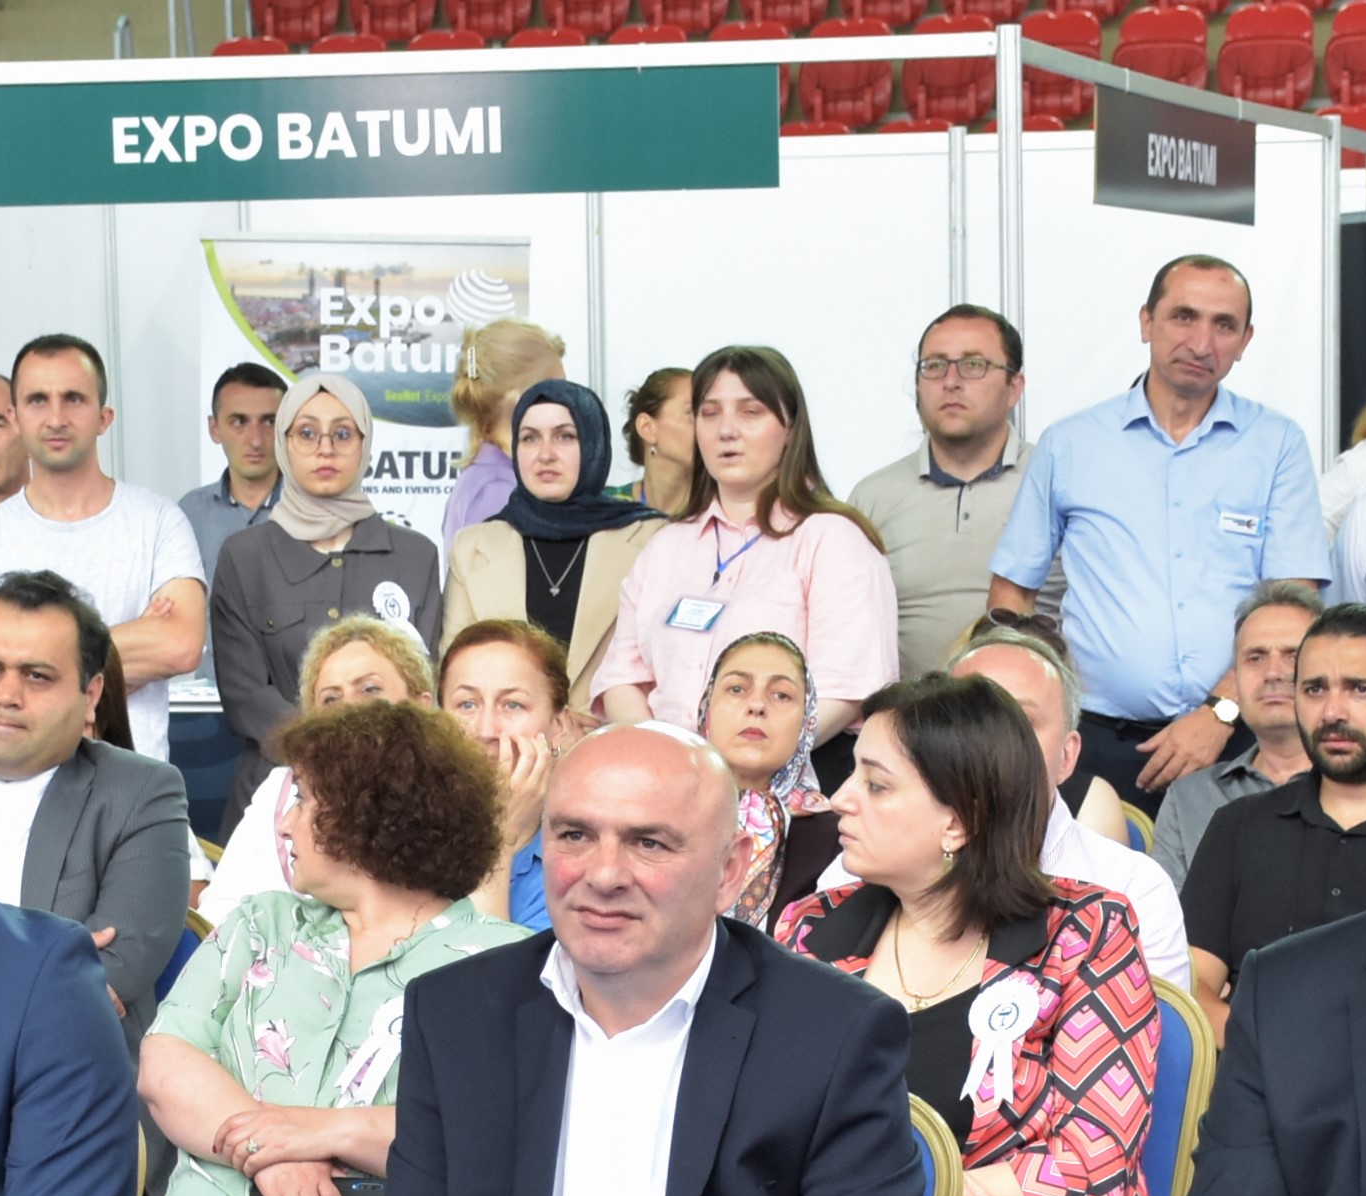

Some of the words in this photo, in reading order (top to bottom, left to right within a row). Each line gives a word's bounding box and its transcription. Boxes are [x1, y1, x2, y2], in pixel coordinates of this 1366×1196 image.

[112, 113, 263, 164] EXPO
[277, 105, 502, 160] BATUMI
[1147, 132, 1177, 179] EXPO
[1177, 138, 1217, 186] BATUMI
[320, 287, 445, 338] Expo
[381, 486, 403, 494] AND
[405, 486, 442, 495] EVENTS
